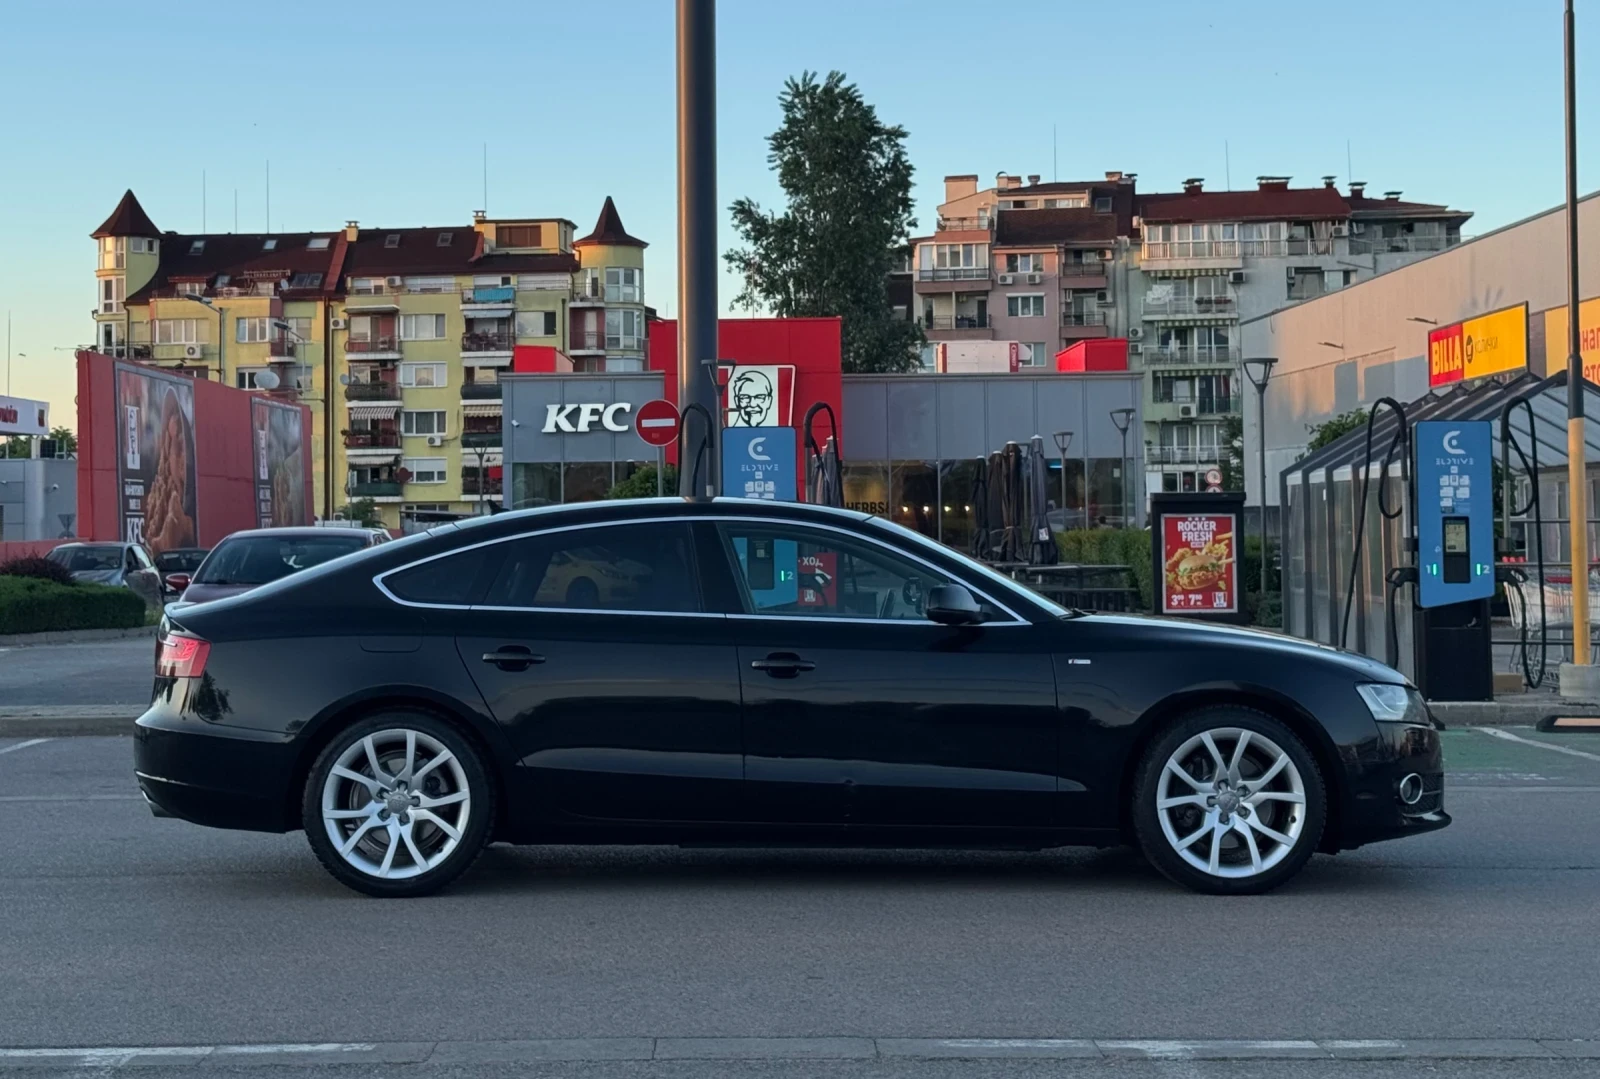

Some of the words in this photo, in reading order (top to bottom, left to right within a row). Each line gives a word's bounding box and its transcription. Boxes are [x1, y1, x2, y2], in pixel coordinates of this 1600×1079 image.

[1432, 335, 1462, 376] BILLA
[541, 402, 631, 433] KFC
[1435, 457, 1474, 466] ELDRIVE
[741, 463, 779, 472] ELDRIVE
[126, 517, 145, 544] KFC
[1177, 521, 1216, 532] ROCKER
[1182, 531, 1212, 542] FRESH
[1483, 564, 1490, 574] 2
[786, 571, 794, 580] 2
